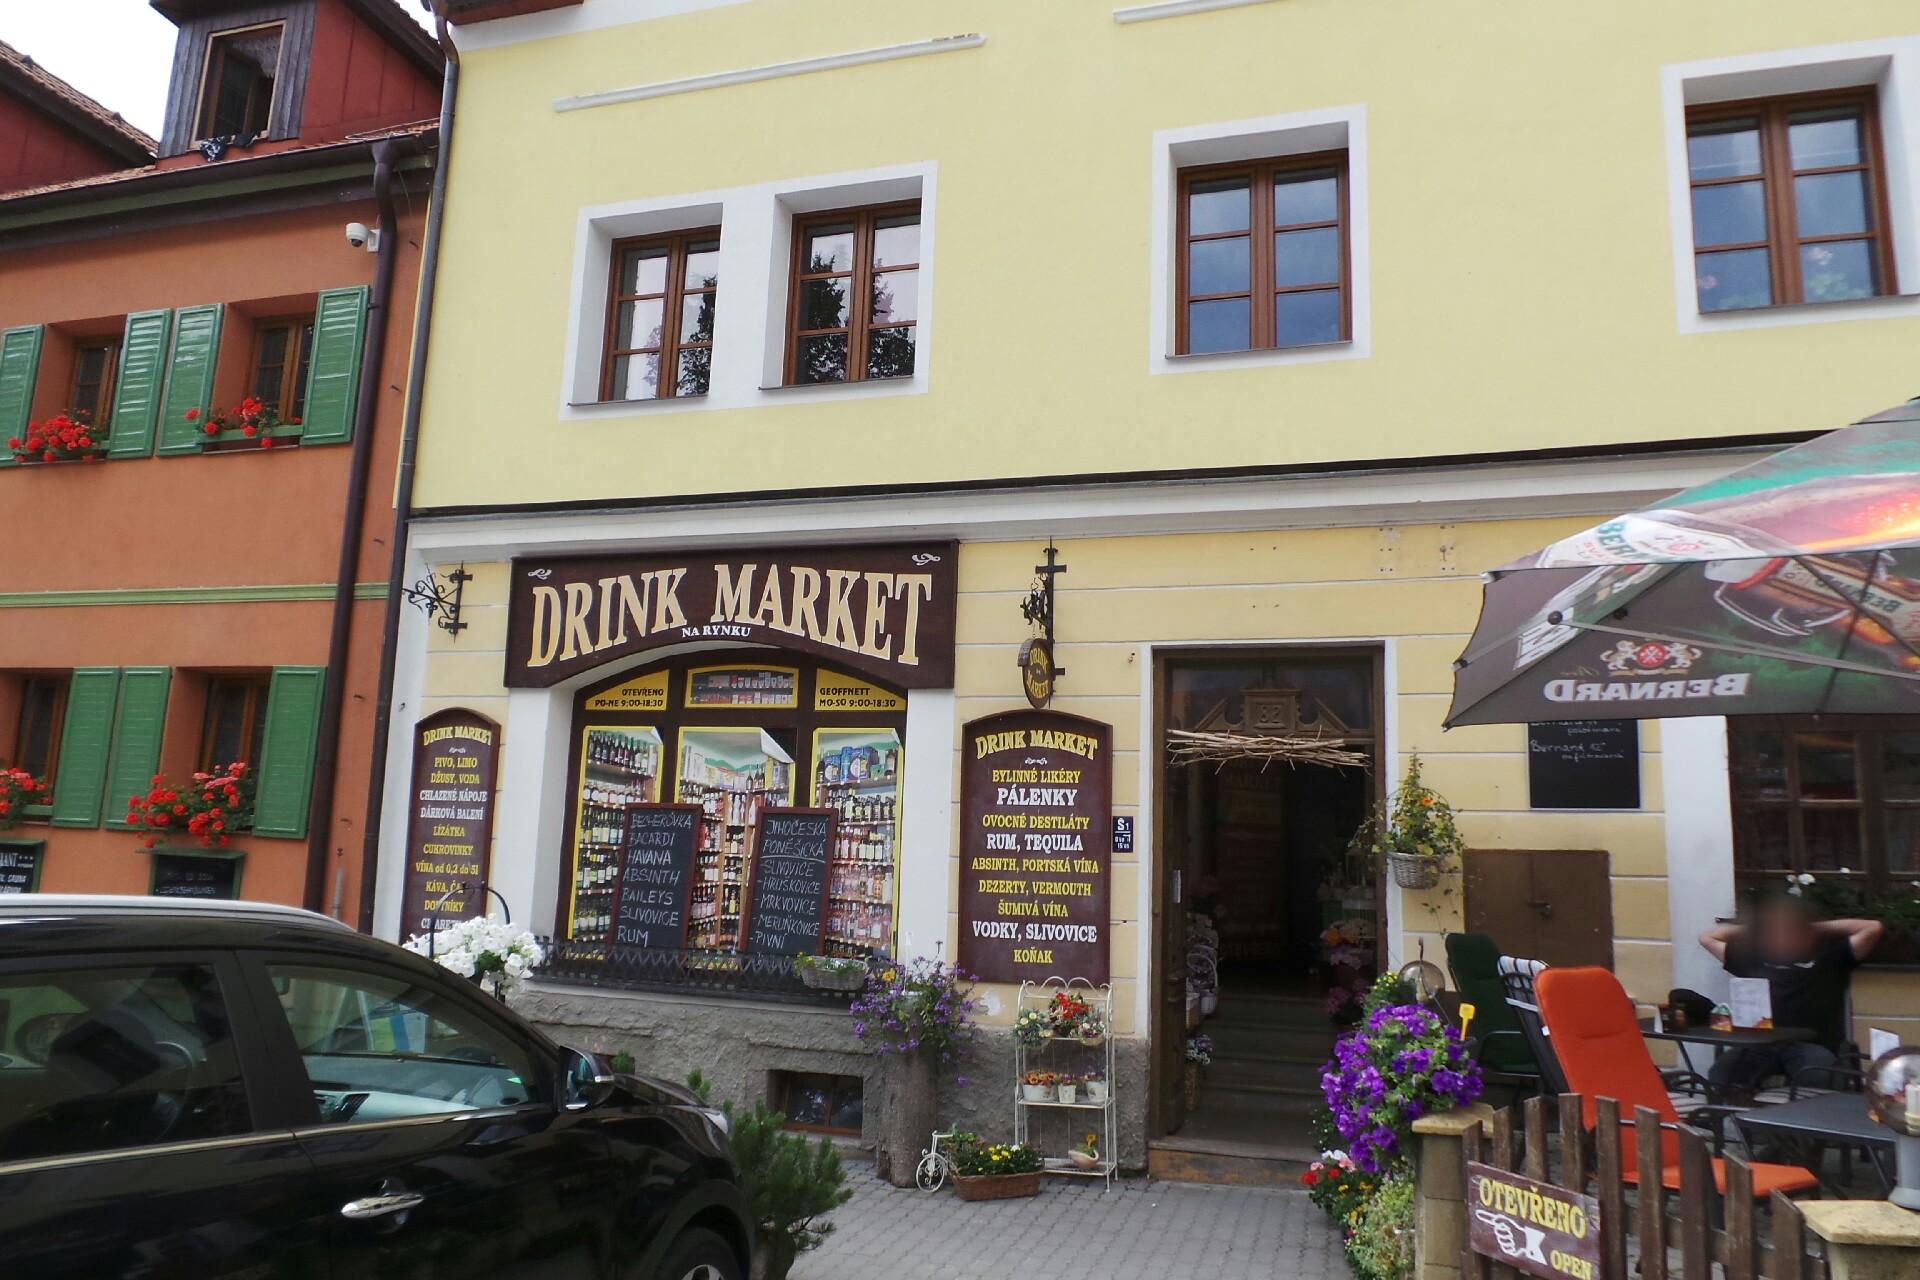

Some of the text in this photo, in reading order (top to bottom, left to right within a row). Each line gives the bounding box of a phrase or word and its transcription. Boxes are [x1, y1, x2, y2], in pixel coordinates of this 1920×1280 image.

[527, 563, 932, 667] DRINK MARKET
[682, 625, 752, 638] NA RYNKU
[1030, 647, 1048, 675] DRINK
[622, 686, 664, 697] OTEVŘENO
[819, 687, 870, 697] GEOFFNETT
[1027, 670, 1049, 698] MARKET
[595, 699, 663, 708] PO-NE 9:00-18:30
[849, 699, 896, 708] 9:00-18:30
[423, 726, 492, 746] DRINK MARKET
[975, 730, 1098, 760] DRINK MARKET
[434, 757, 477, 769] PIVO, LIMO
[431, 771, 480, 785] DŽUSY, VODA
[992, 767, 1081, 783] BYLINNÉ LIKÉRY
[420, 788, 488, 802] CHLAZENÉ NÁPOJE
[997, 784, 1078, 806] PÁLENKY
[420, 805, 484, 820] DÁRKOVÁ BALENÍ
[982, 813, 1089, 830] OVOCNÉ DESTILÁTY
[433, 823, 465, 837] LÍZÁTKA
[628, 832, 675, 847] BACARDI
[986, 834, 1083, 854] RUM, TEQUILA
[423, 844, 474, 855] CUKROVINKY
[627, 850, 672, 865] HAVANA
[416, 860, 433, 873] VÍNA
[435, 863, 444, 873] od
[446, 863, 458, 875] 0,2
[460, 864, 469, 875] do
[972, 857, 1099, 873] ABSINTH, PORTSKÁ VÍNA
[623, 868, 680, 886] ABSINTH
[978, 880, 1092, 896] DEZERTY, VERMOUTH
[622, 888, 674, 905] BAILEYS
[998, 899, 1069, 917] ŠUMIVÁ VÍNA
[619, 906, 679, 927] SLIVOVICE
[617, 925, 649, 948] RUM
[972, 920, 1098, 943] VODKY, SLIVOVICE
[1013, 946, 1053, 964] KOŇAK
[1480, 1178, 1586, 1239] OTEVŘENO
[1550, 1249, 1592, 1280] OPEN
